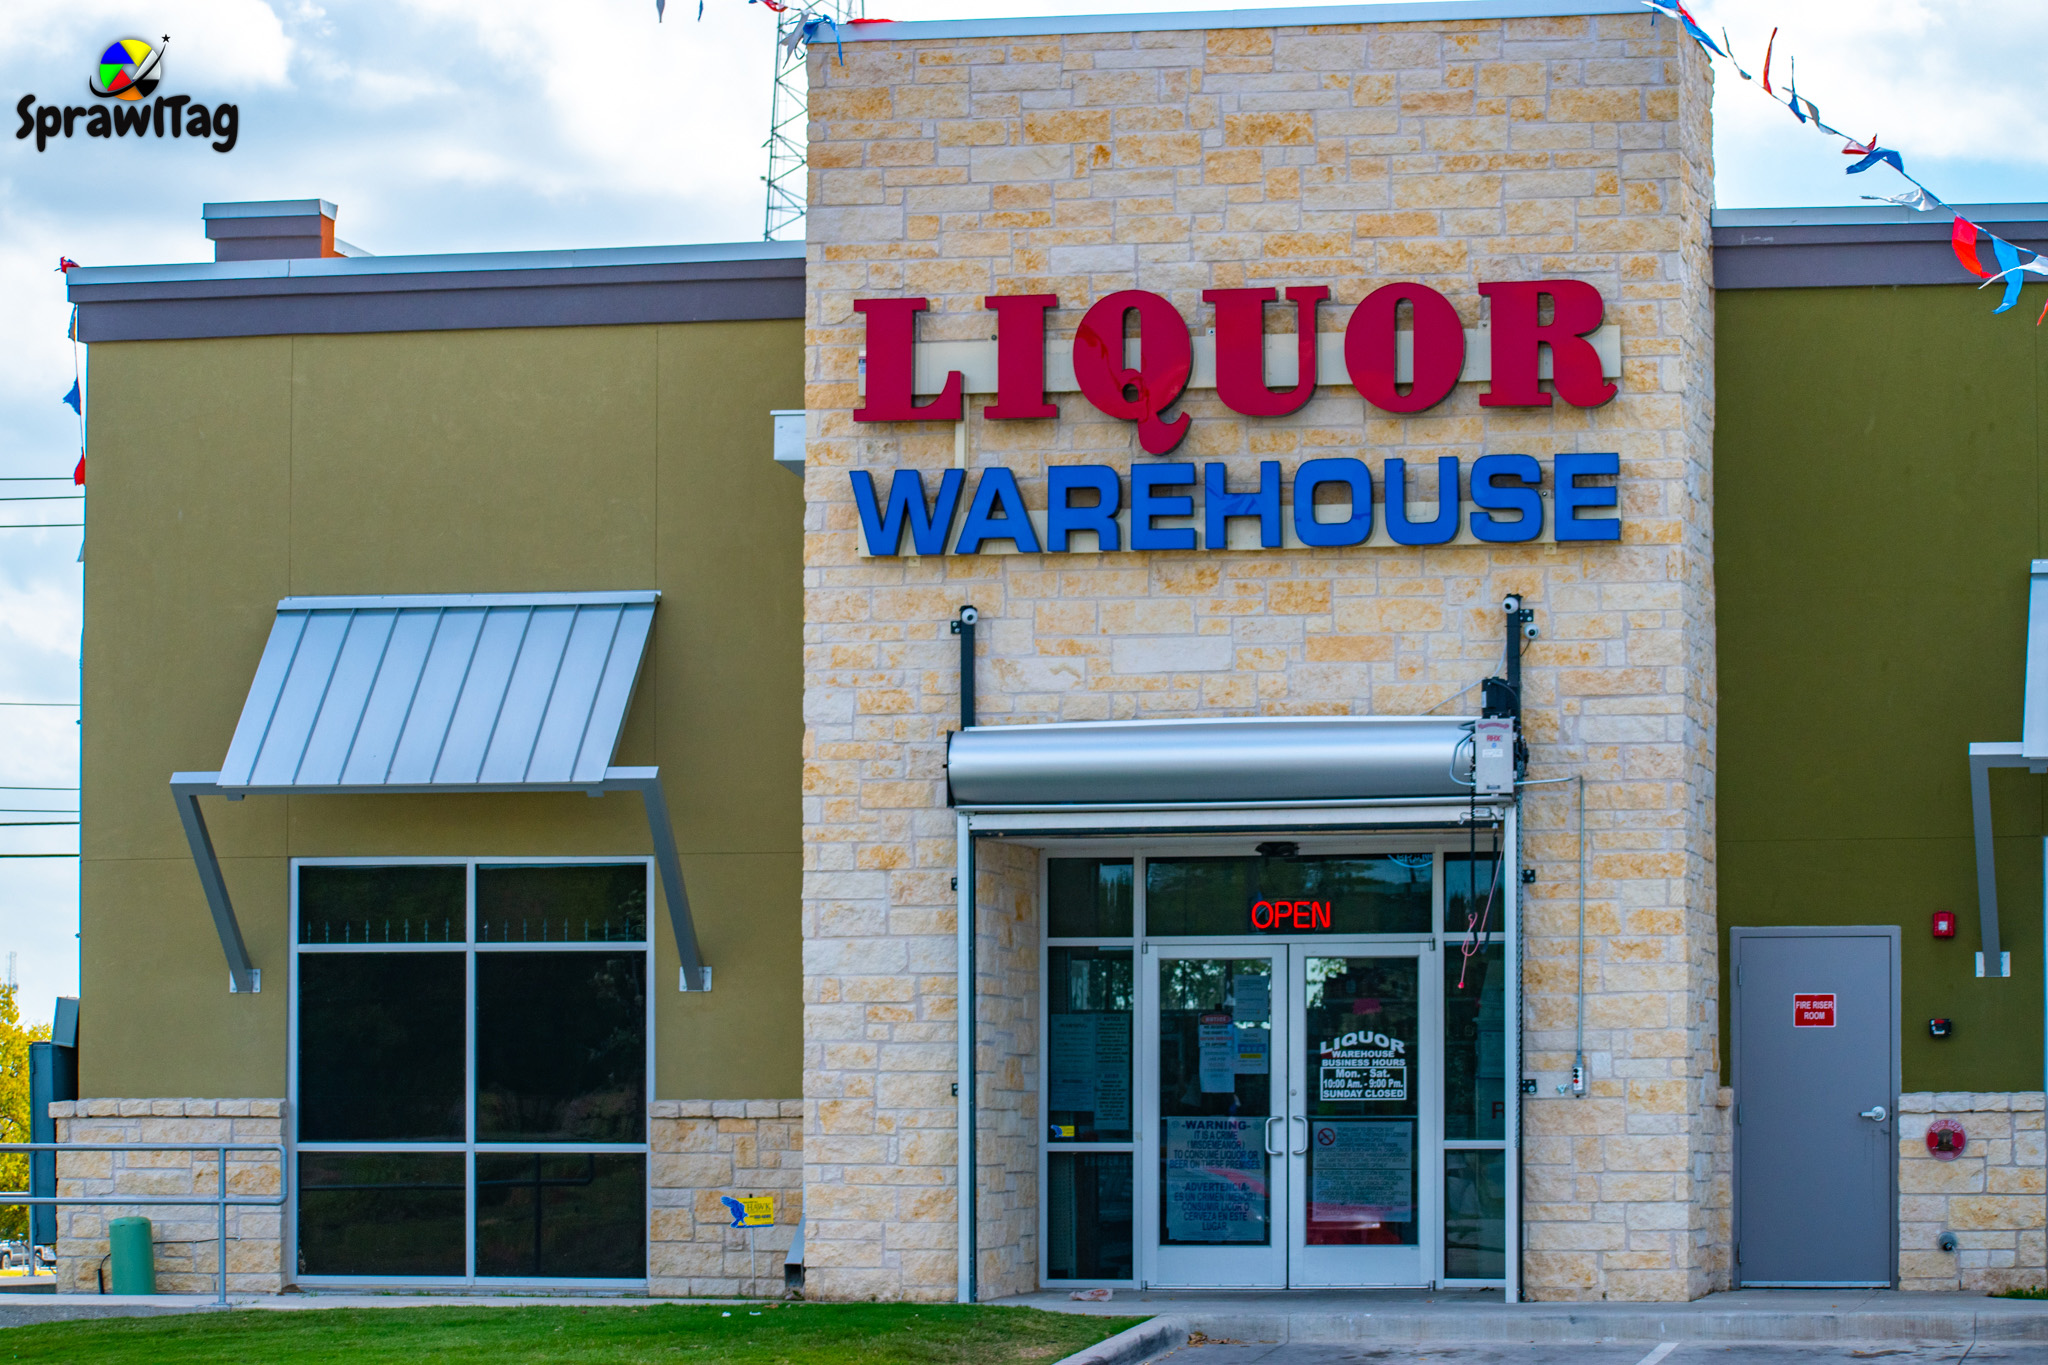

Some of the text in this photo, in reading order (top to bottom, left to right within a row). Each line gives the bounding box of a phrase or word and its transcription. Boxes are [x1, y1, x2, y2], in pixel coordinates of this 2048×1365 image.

[852, 278, 1619, 456] LIQUOR
[848, 451, 1622, 558] WAREHOUSE
[1251, 900, 1331, 929] OPEN
[1796, 1001, 1834, 1010] FIRE RISER
[1803, 1011, 1826, 1020] ROOM
[1320, 1030, 1406, 1054] LIQUOR
[1331, 1050, 1396, 1058] WAREHOUSE
[1321, 1058, 1406, 1067] BUSINESS HOURS
[1335, 1069, 1361, 1078] Mon.
[1369, 1068, 1391, 1078] Sat.
[1323, 1079, 1346, 1088] 10:00
[1346, 1079, 1363, 1088] Am.
[1368, 1079, 1387, 1088] 9:00
[1388, 1079, 1404, 1088] Pm.
[1323, 1089, 1404, 1098] SUNDAY CLOSED
[1193, 1131, 1238, 1140] IT IS A CRIME
[1174, 1150, 1258, 1160] TO CONSUME LIQUOR OR
[1169, 1159, 1189, 1169] BEER
[1189, 1159, 1201, 1169] ON
[1201, 1159, 1224, 1169] THESE
[1174, 1192, 1184, 1201] ES
[1185, 1192, 1196, 1201] UN
[1196, 1192, 1224, 1201] CRIMEN
[1181, 1202, 1250, 1211] CONSUMIR LICOR O
[1183, 1212, 1248, 1221] CERVEZA EN ESTE
